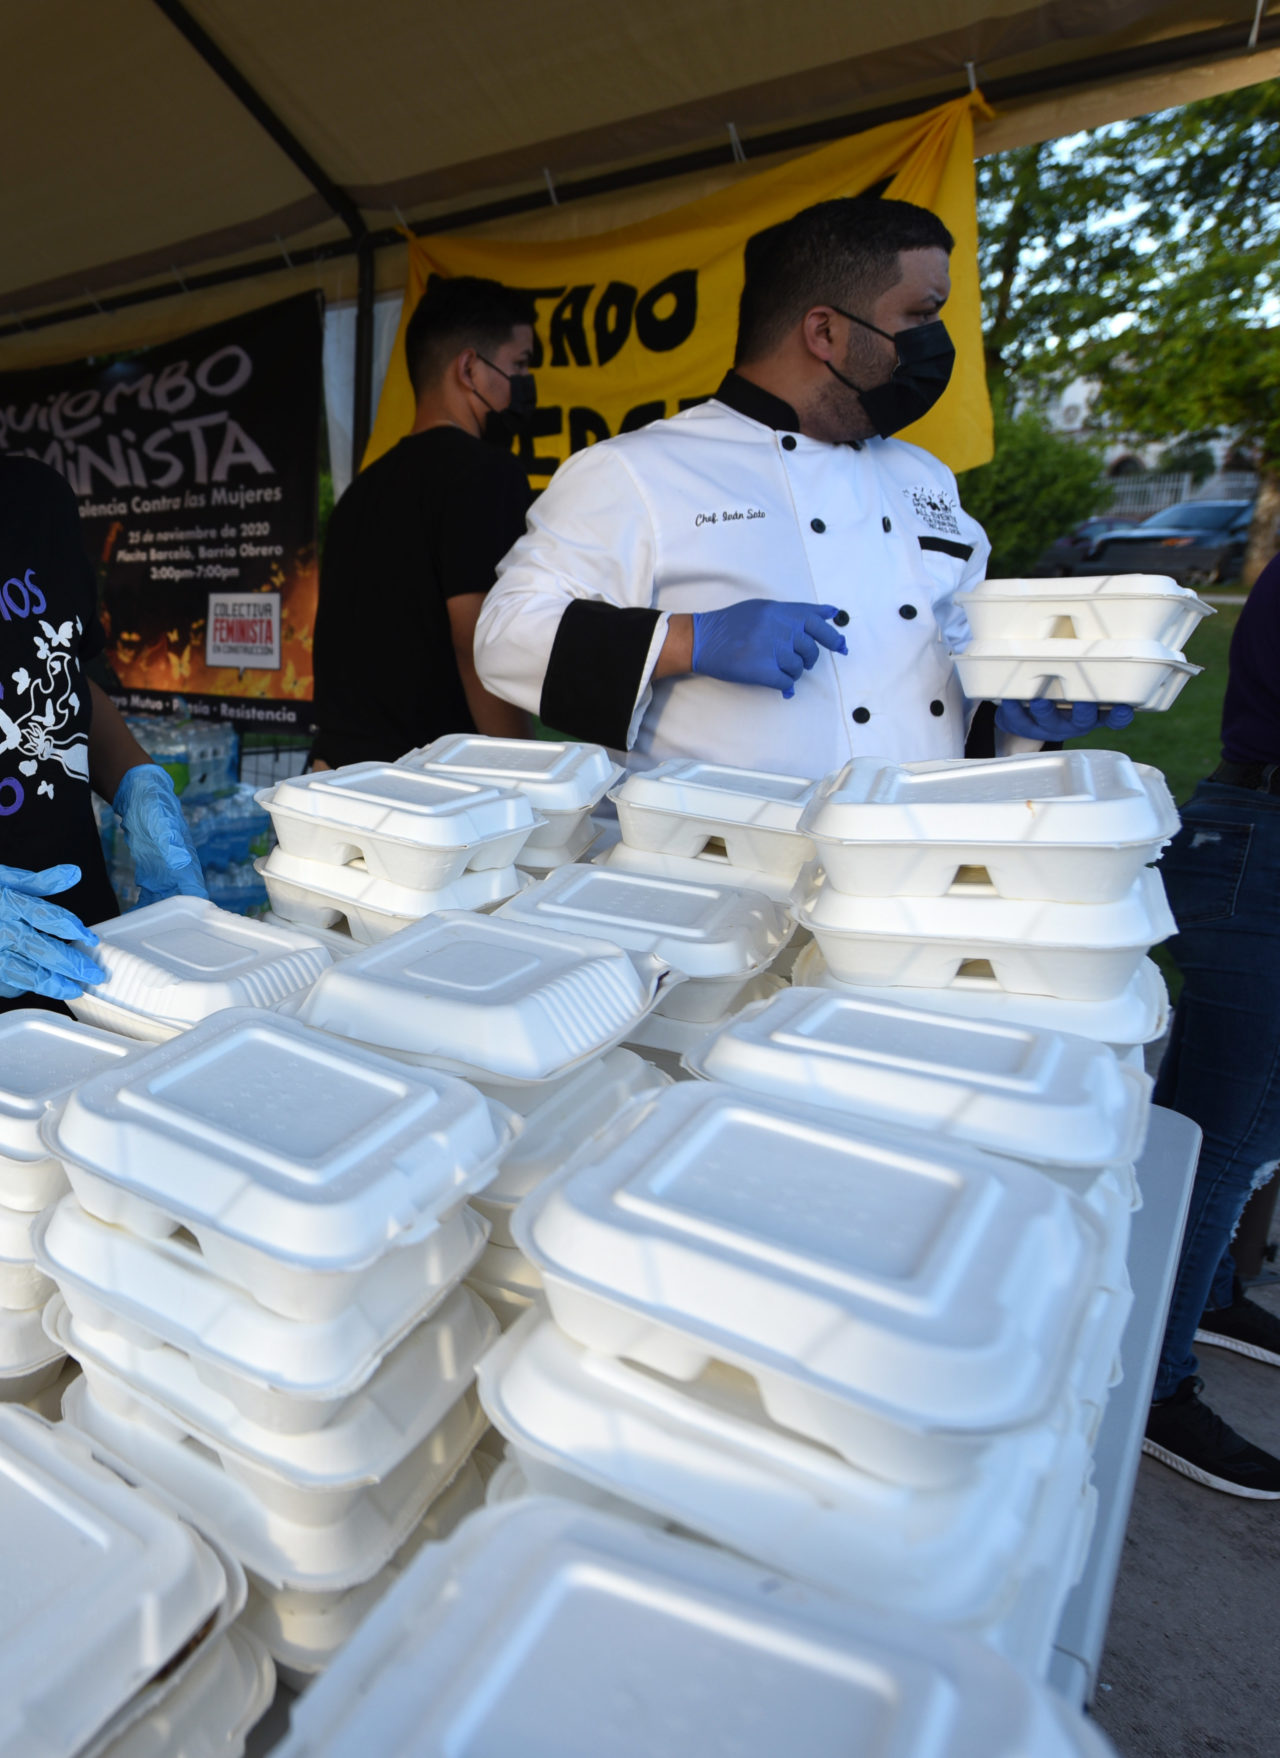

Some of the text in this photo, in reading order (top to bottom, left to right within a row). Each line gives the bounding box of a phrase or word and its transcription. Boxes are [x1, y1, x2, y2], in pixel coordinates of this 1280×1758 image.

[131, 494, 181, 515] Contra
[184, 489, 206, 509] las
[211, 485, 282, 510] Mujeres
[746, 508, 766, 520] Soto
[128, 521, 270, 546] 25 de noviembre de 2020
[198, 544, 236, 559] Barrio
[239, 542, 283, 557] Obrero
[213, 617, 273, 644] FEMINISTA
[129, 694, 164, 711] Mutuo
[220, 703, 297, 723] Resistencia
